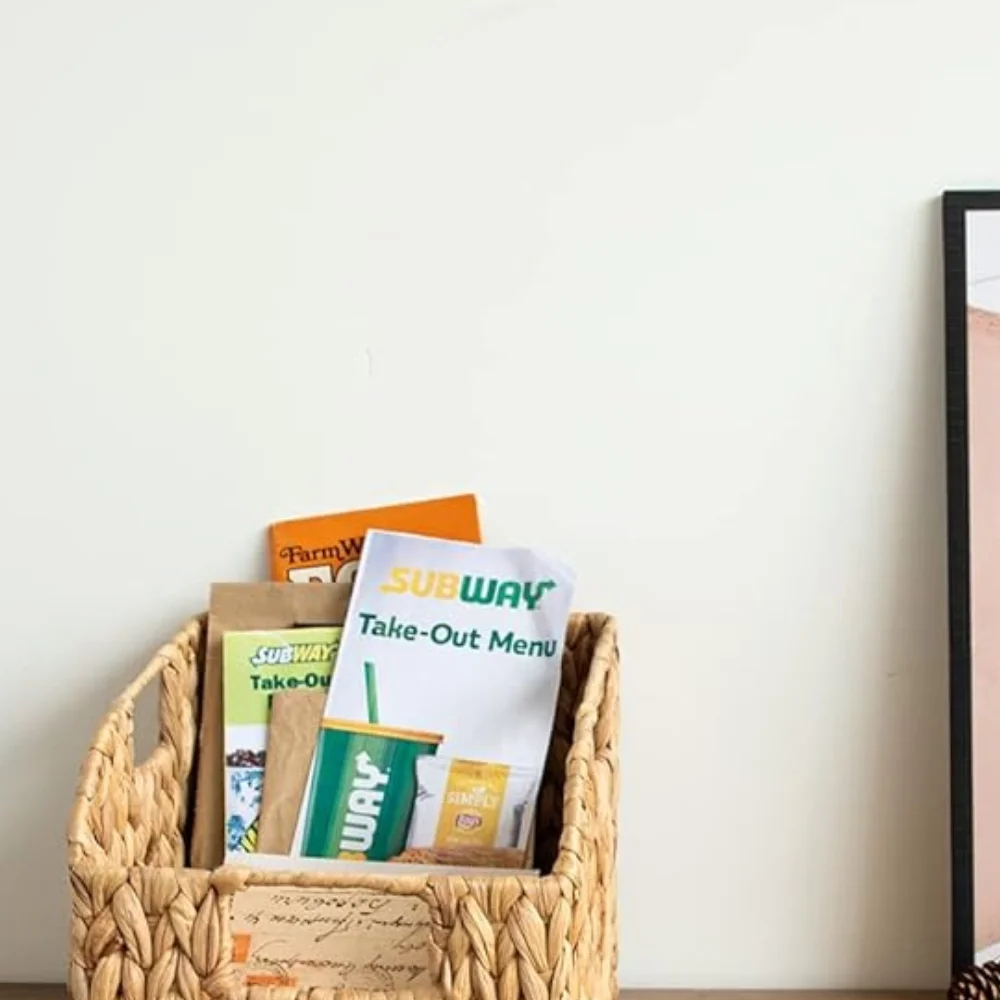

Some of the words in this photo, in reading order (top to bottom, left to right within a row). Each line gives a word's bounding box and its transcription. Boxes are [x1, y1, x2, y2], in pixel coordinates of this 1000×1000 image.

[280, 536, 364, 564] FarmW
[379, 567, 556, 610] SUBWAY
[359, 612, 481, 650] Take-Out
[488, 630, 557, 658] Menu
[249, 639, 339, 667] SUBWAY
[250, 672, 330, 690] Take-Ou
